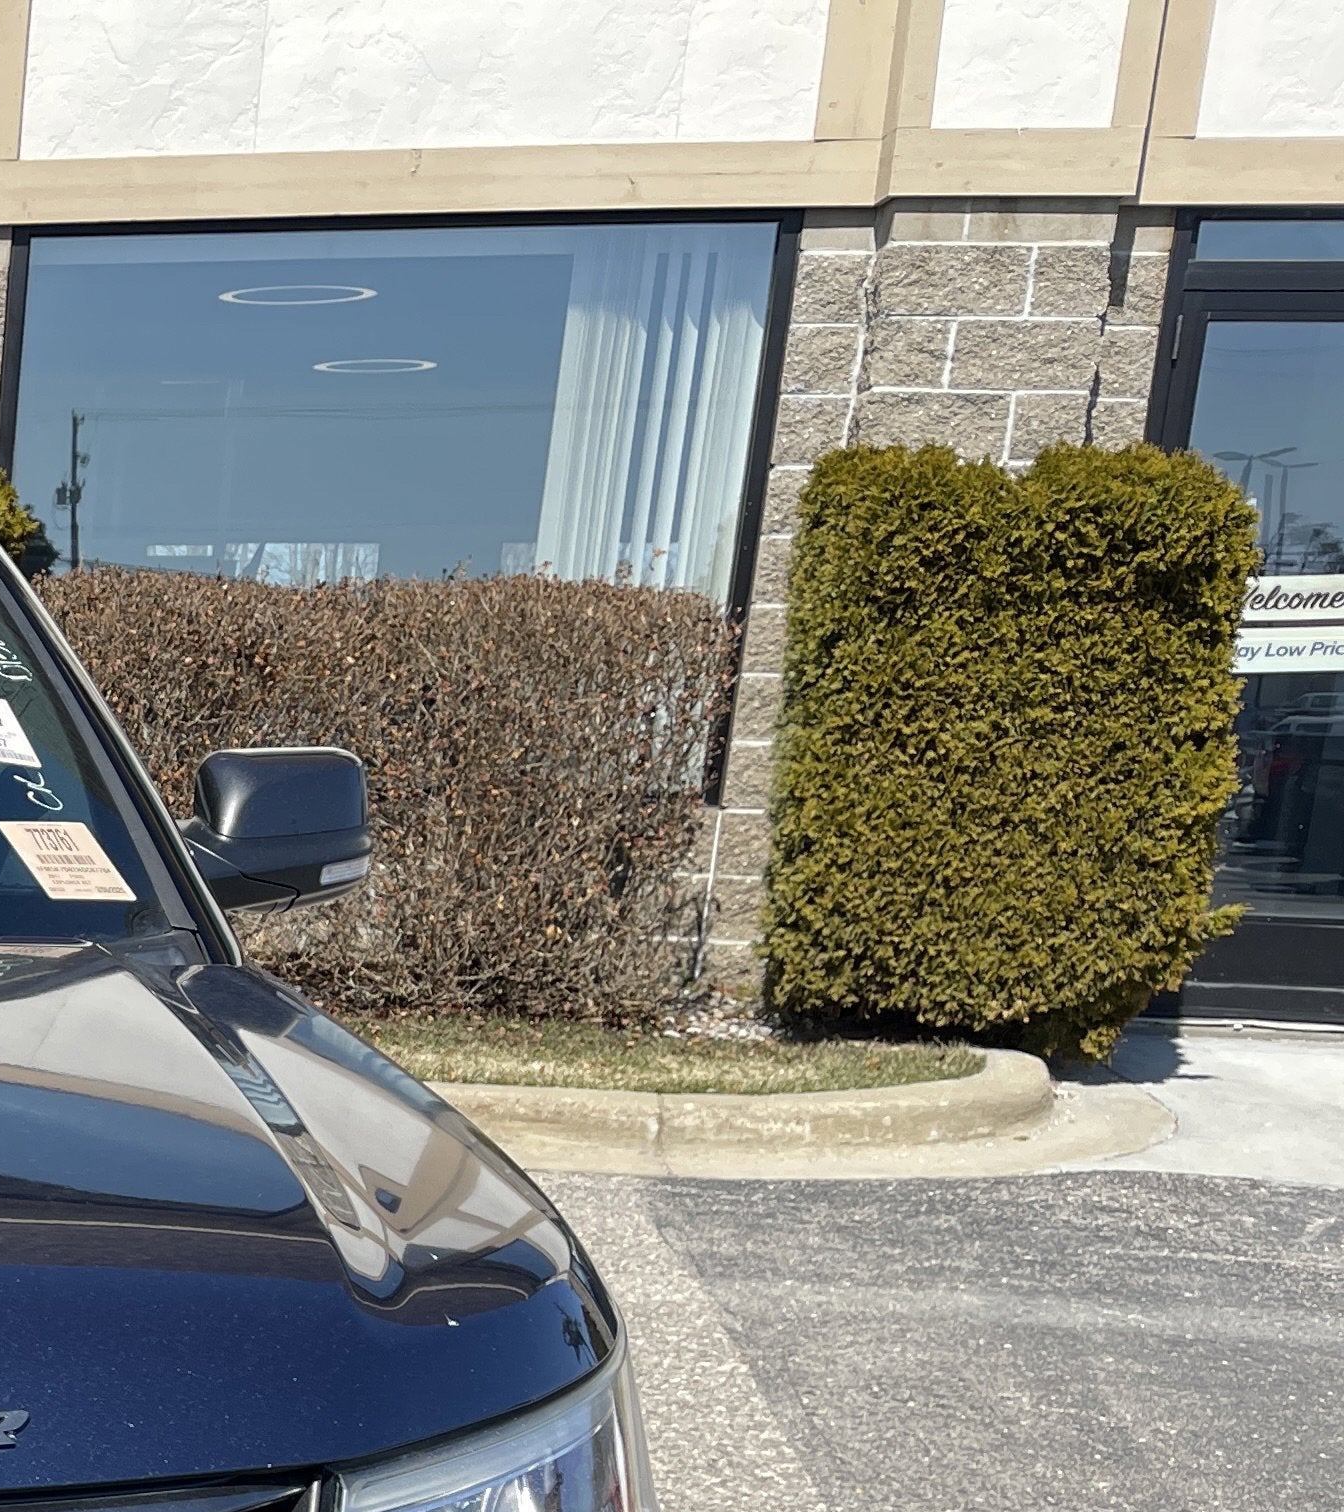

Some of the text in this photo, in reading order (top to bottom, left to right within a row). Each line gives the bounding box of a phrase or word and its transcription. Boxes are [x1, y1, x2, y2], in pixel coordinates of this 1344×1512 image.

[1235, 645, 1263, 662] ay
[1264, 642, 1307, 658] Low
[23, 827, 81, 852] 773761
